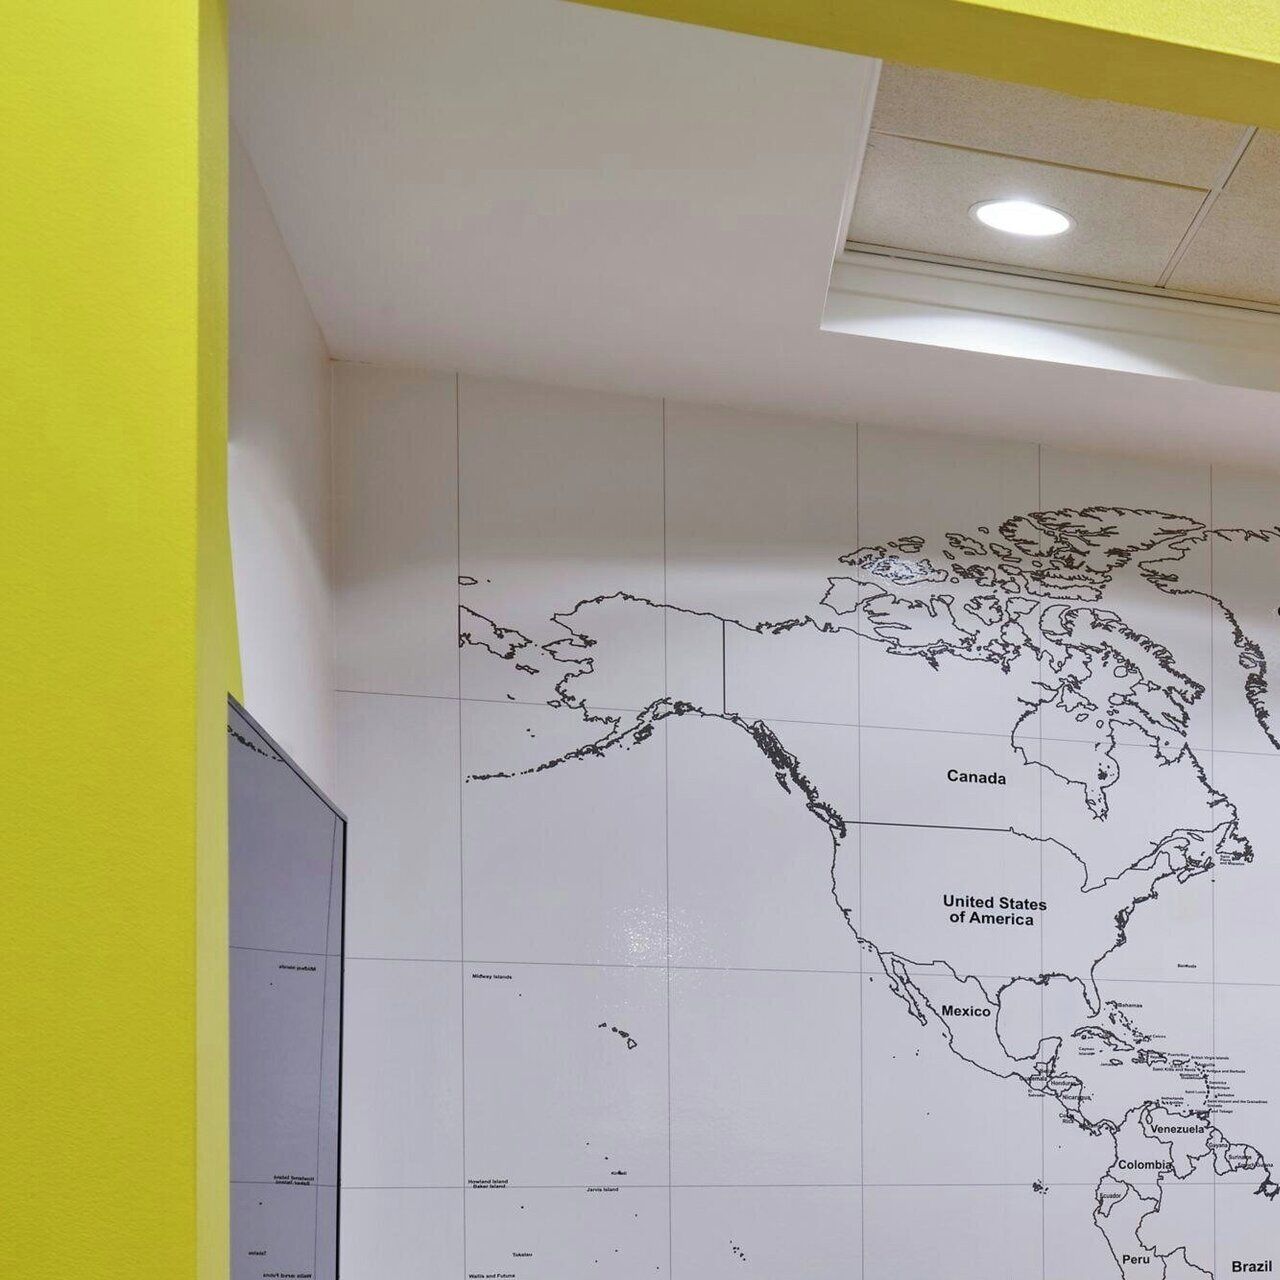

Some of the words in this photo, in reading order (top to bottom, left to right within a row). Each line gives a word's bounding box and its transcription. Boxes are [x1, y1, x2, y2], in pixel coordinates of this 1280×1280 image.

[947, 769, 1006, 785] Canada
[943, 894, 994, 909] United
[999, 897, 1047, 911] States
[950, 911, 965, 923] of
[969, 912, 1034, 926] America
[942, 1005, 991, 1017] Mexico
[1151, 1124, 1205, 1134] Venezuela
[1118, 1159, 1172, 1170] Colombia
[1122, 1254, 1150, 1265] Peru
[1232, 1261, 1273, 1273] Brazil
